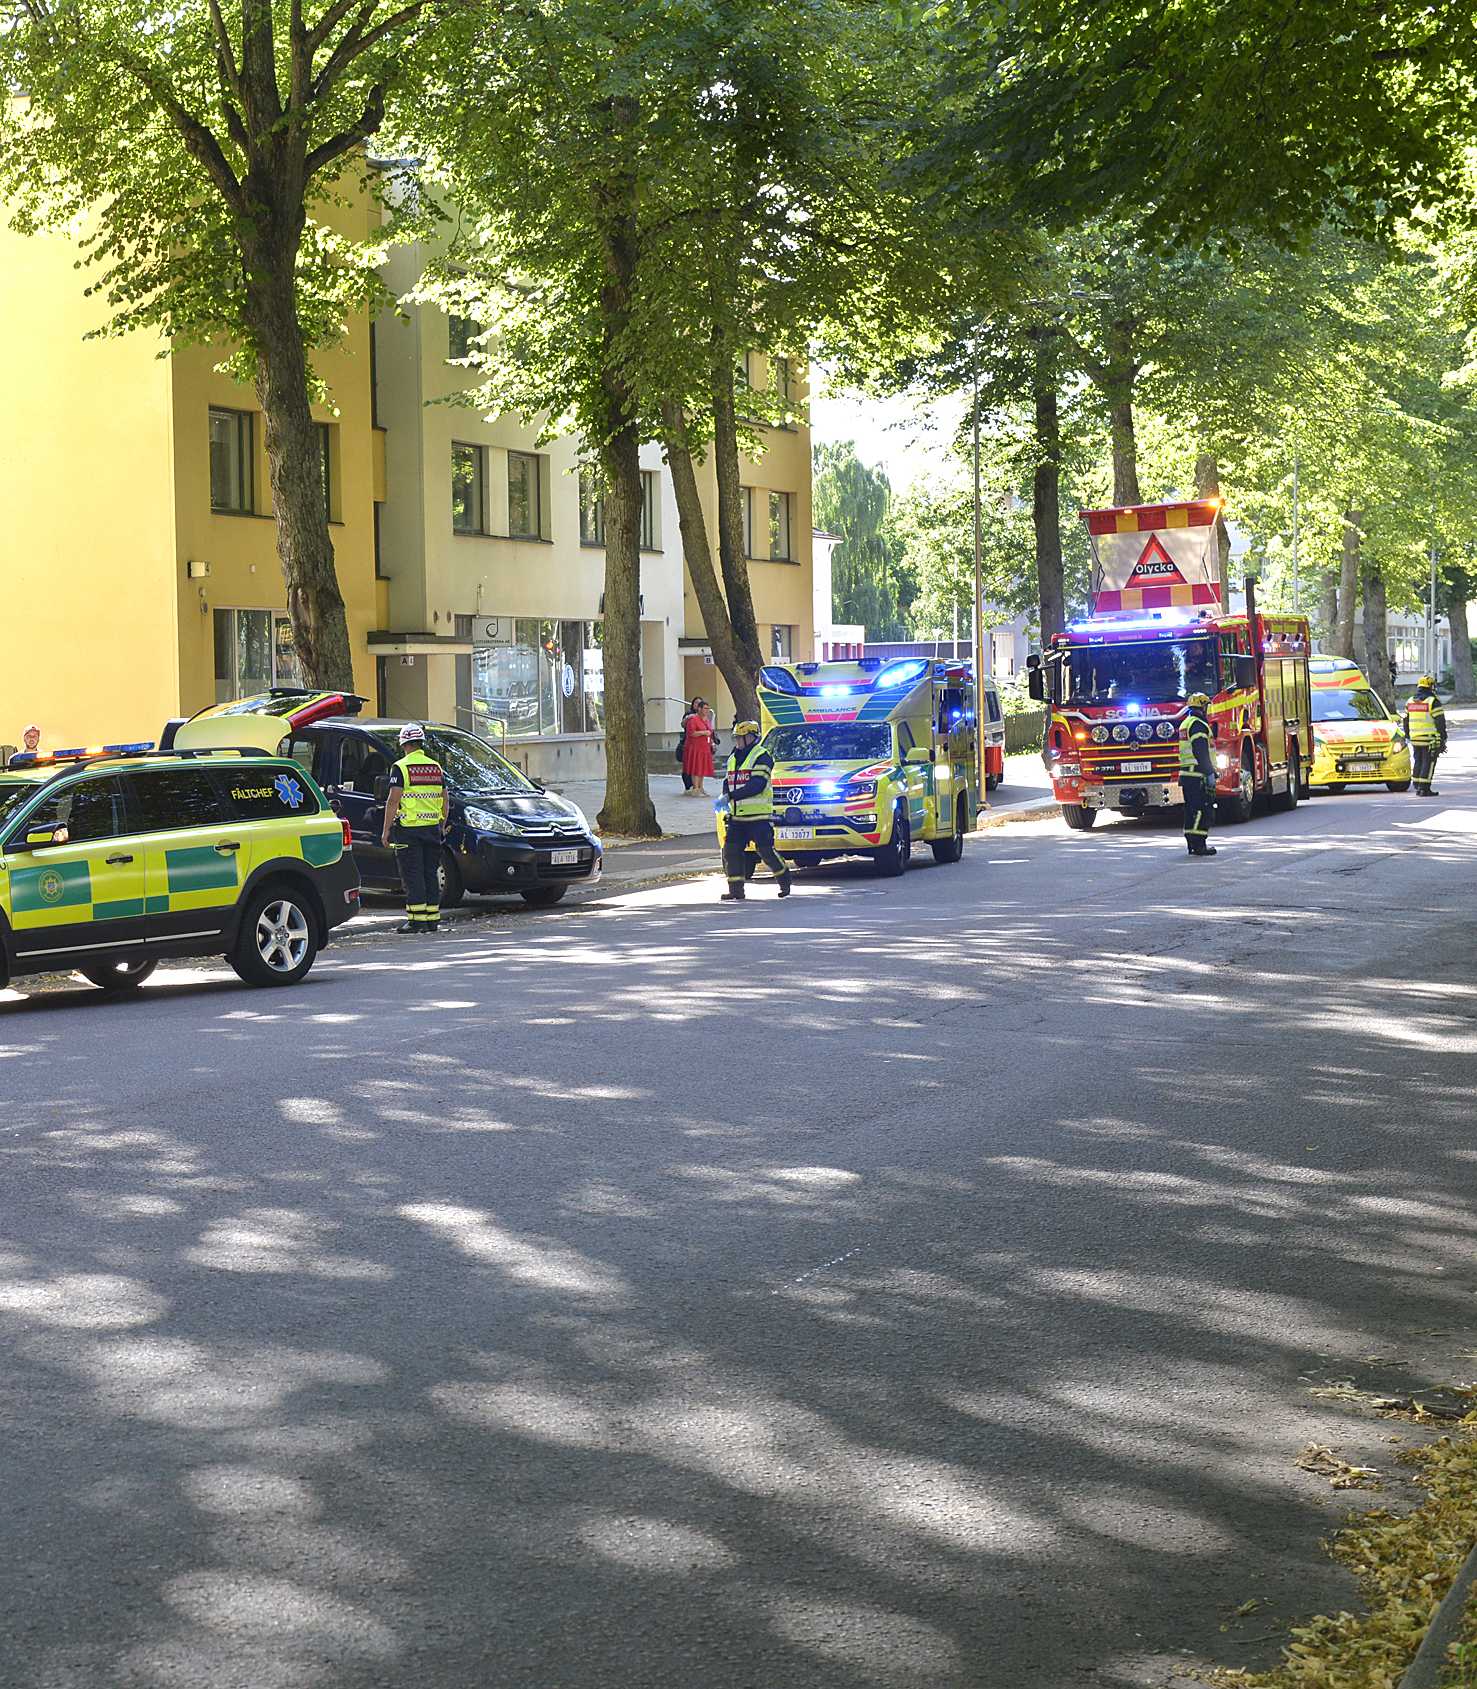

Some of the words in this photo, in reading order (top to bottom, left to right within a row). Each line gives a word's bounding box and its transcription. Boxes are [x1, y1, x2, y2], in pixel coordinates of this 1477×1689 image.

[1136, 562, 1174, 574] Olycka
[402, 657, 408, 665] A
[1105, 707, 1161, 719] SCANIA
[231, 787, 274, 800] FÄLTCHEF
